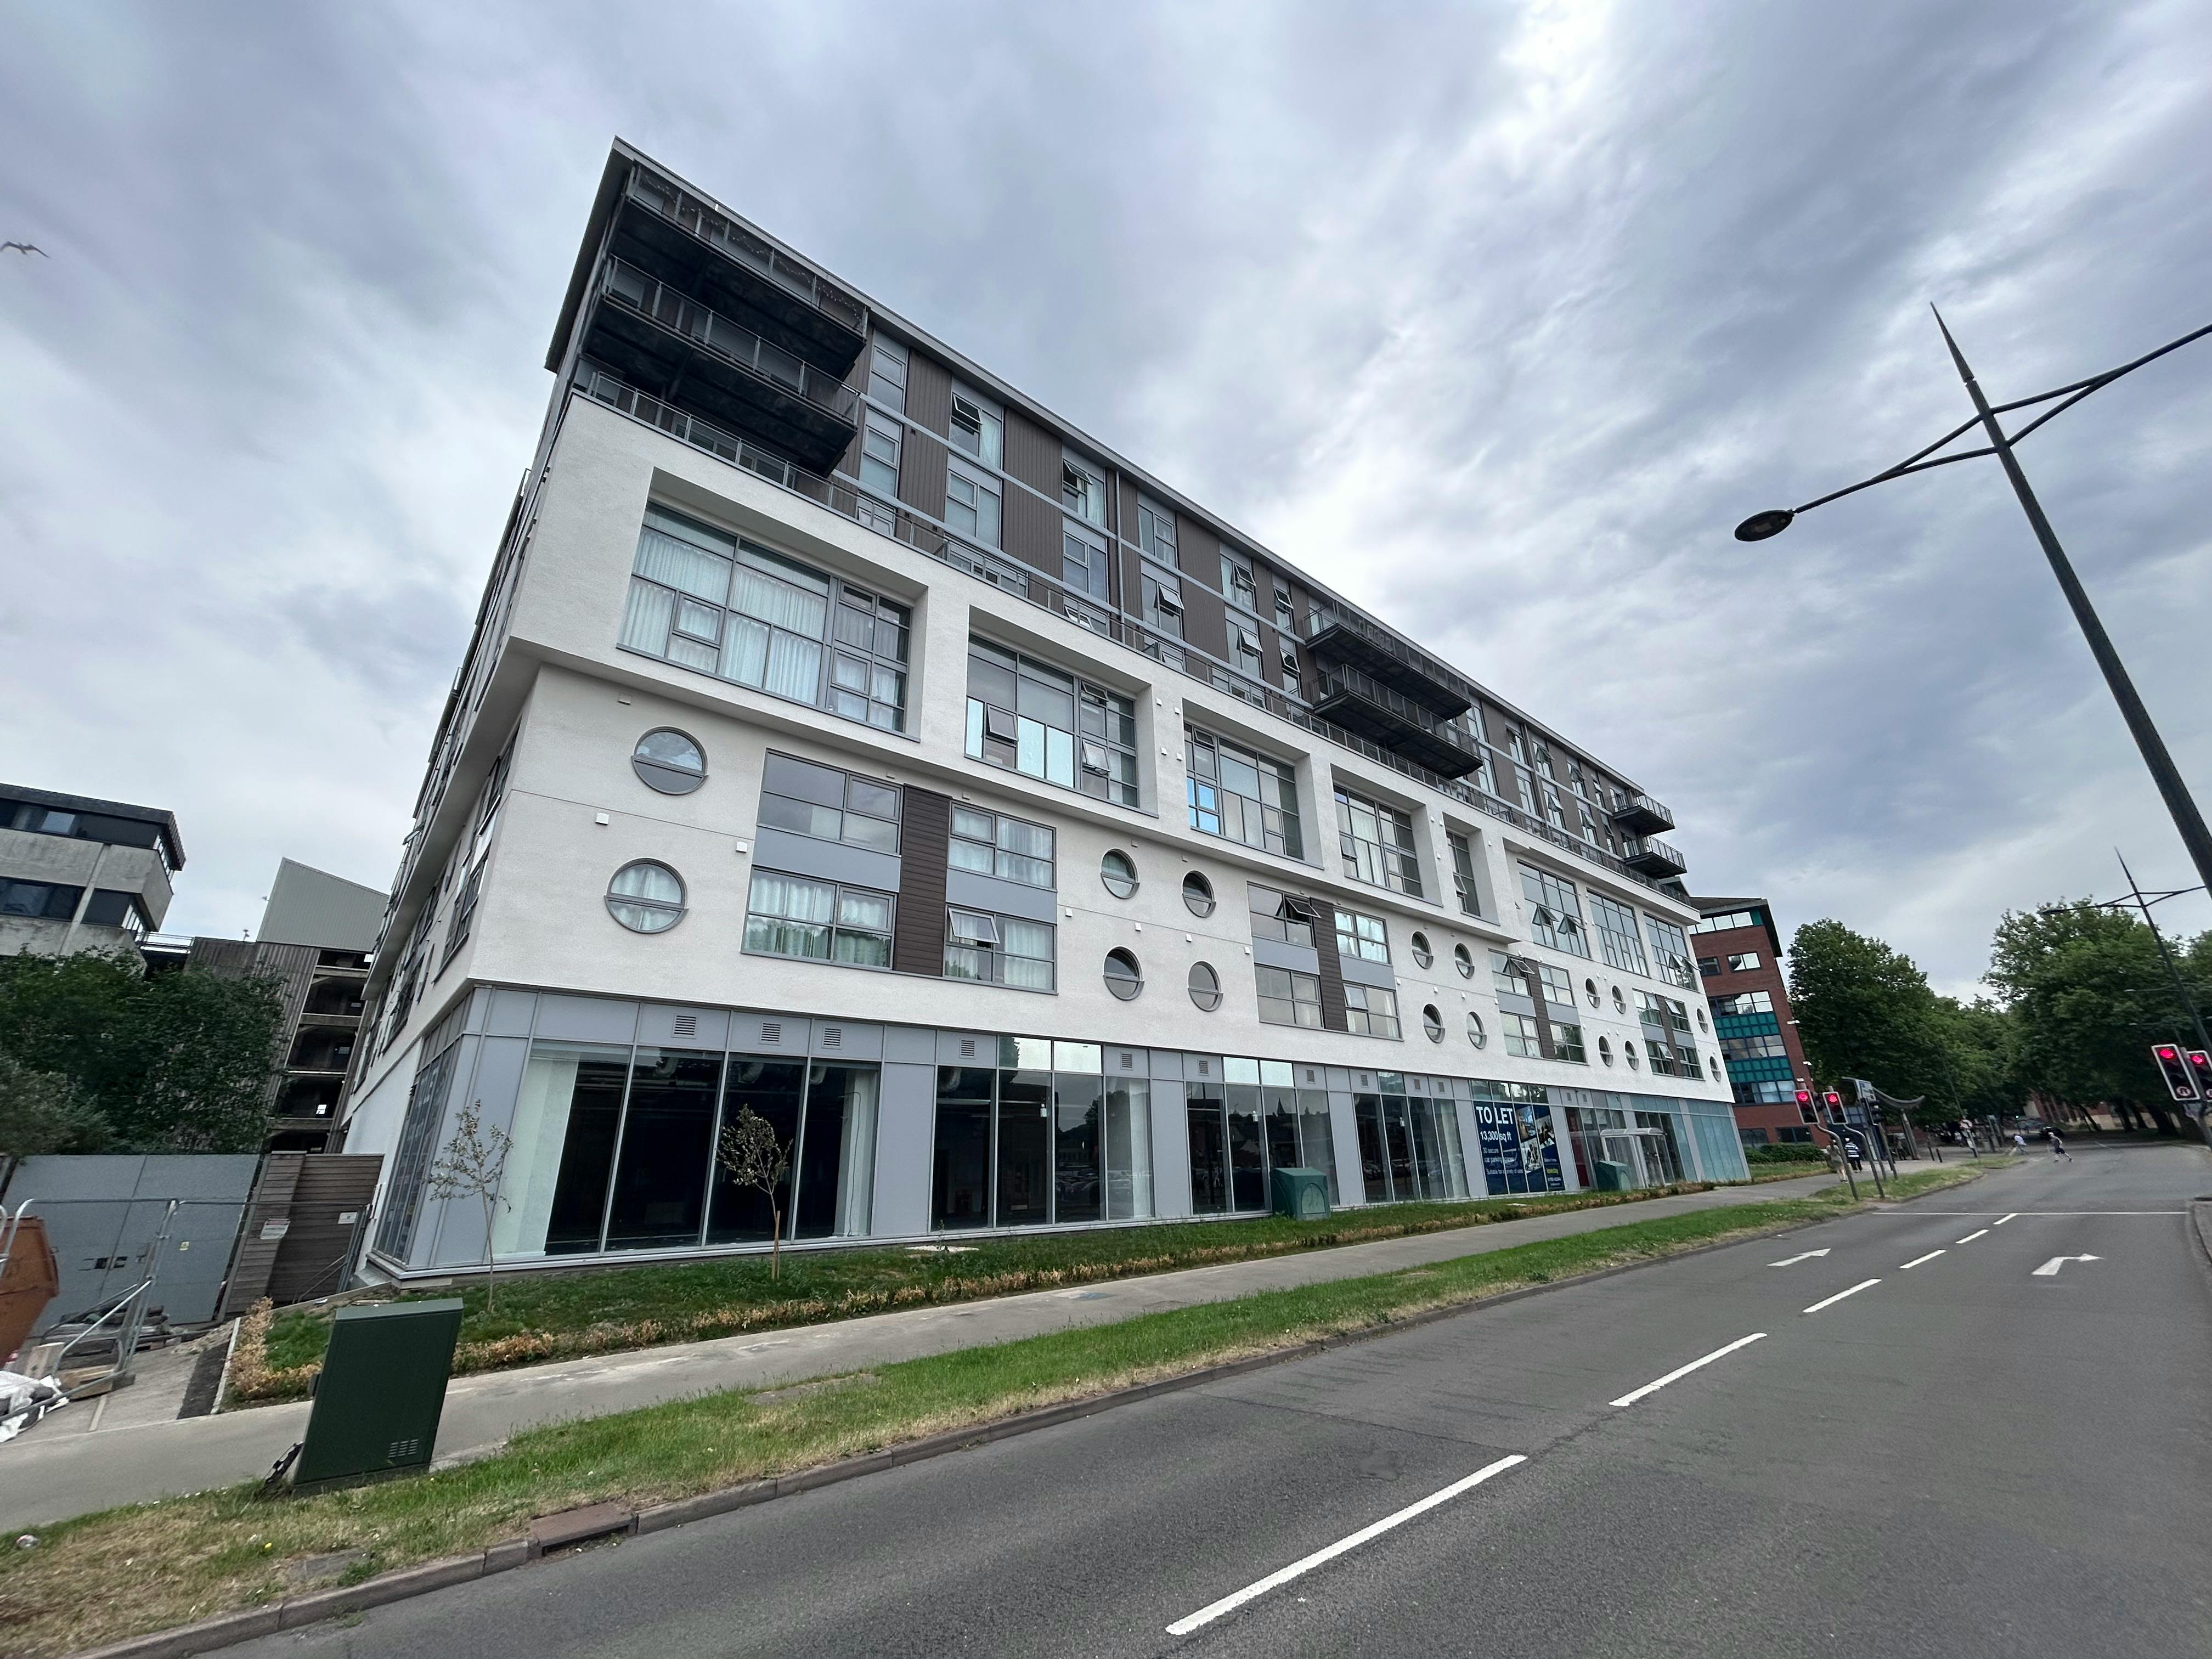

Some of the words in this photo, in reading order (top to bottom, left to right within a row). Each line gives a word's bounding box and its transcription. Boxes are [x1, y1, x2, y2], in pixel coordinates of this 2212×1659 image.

[1475, 1106, 1492, 1124] TO
[1494, 1107, 1513, 1124] LET
[1480, 1131, 1498, 1142] 13,300
[1498, 1133, 1507, 1142] sq
[1506, 1131, 1512, 1141] ft
